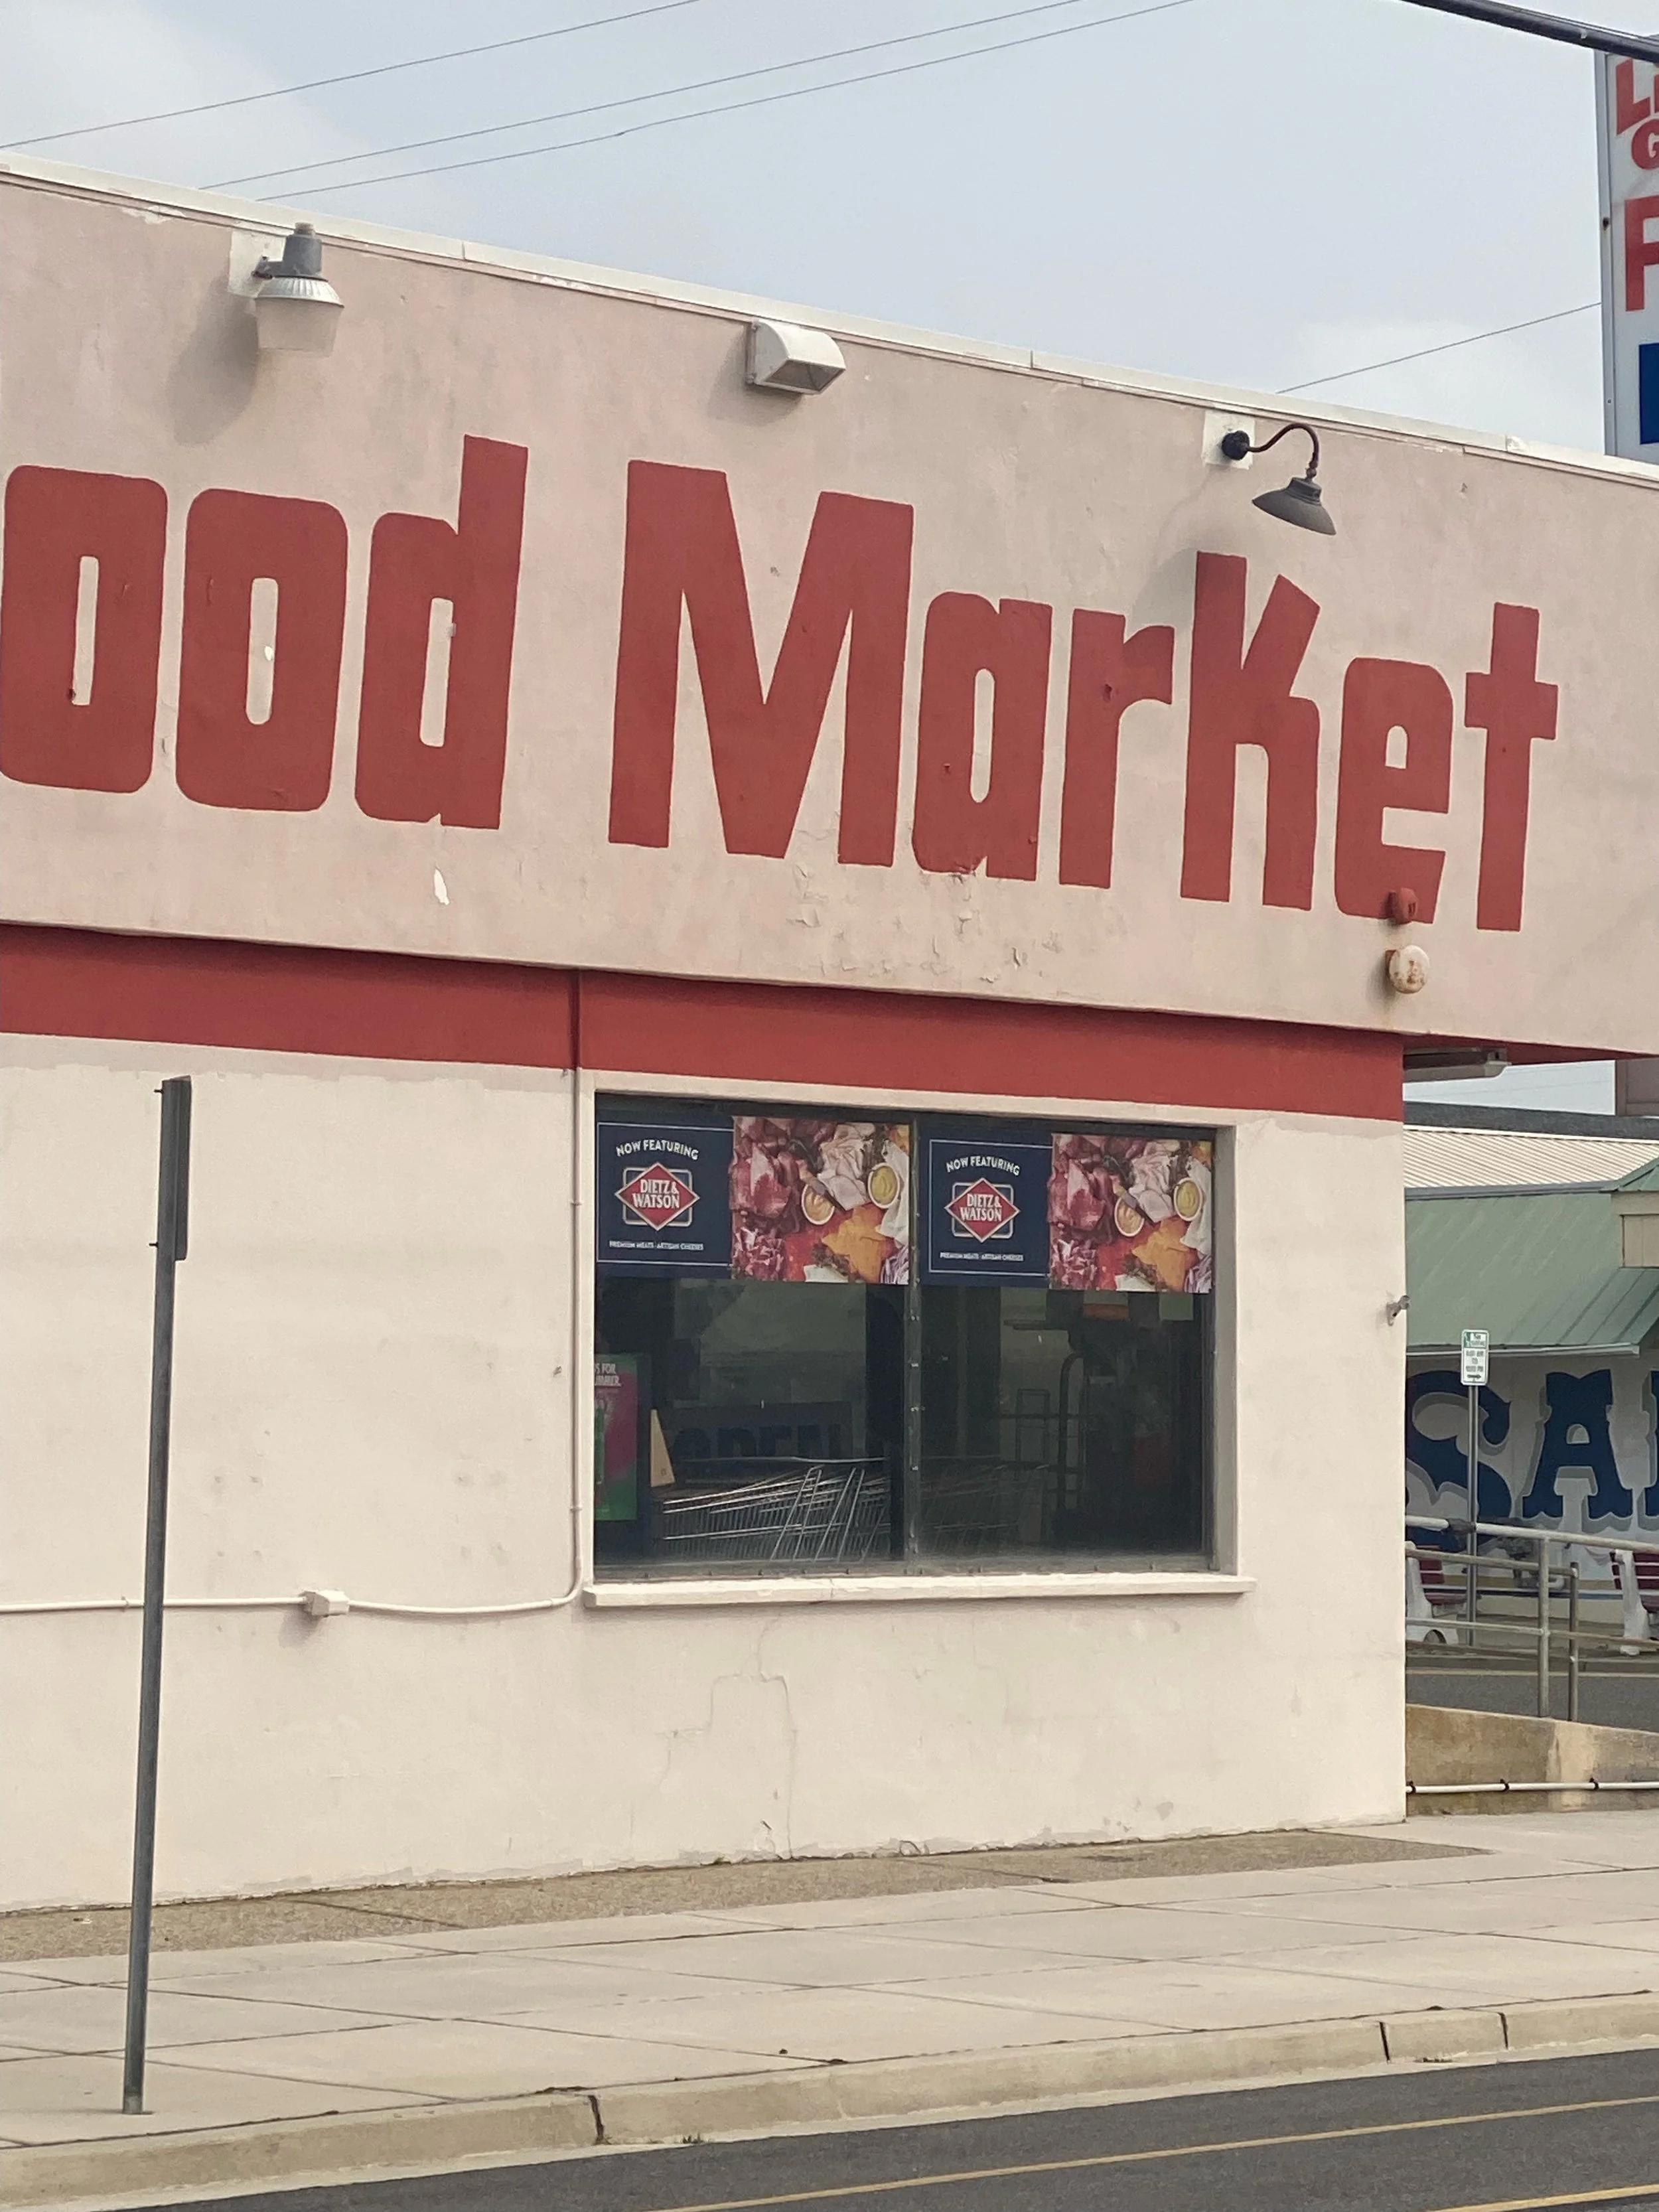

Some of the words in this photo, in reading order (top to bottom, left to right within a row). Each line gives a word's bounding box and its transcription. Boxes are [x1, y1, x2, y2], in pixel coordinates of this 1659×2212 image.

[1616, 57, 1659, 137] L
[0, 435, 529, 830] ood
[609, 460, 1559, 932] Market
[616, 1140, 642, 1157] NOW
[643, 1140, 699, 1160] FEATURING
[946, 1156, 969, 1173] NOW
[970, 1155, 1021, 1176] FEATURING
[632, 1193, 680, 1209] WATSON
[960, 1207, 1002, 1222] WATSON
[1406, 1369, 1659, 1553] SA
